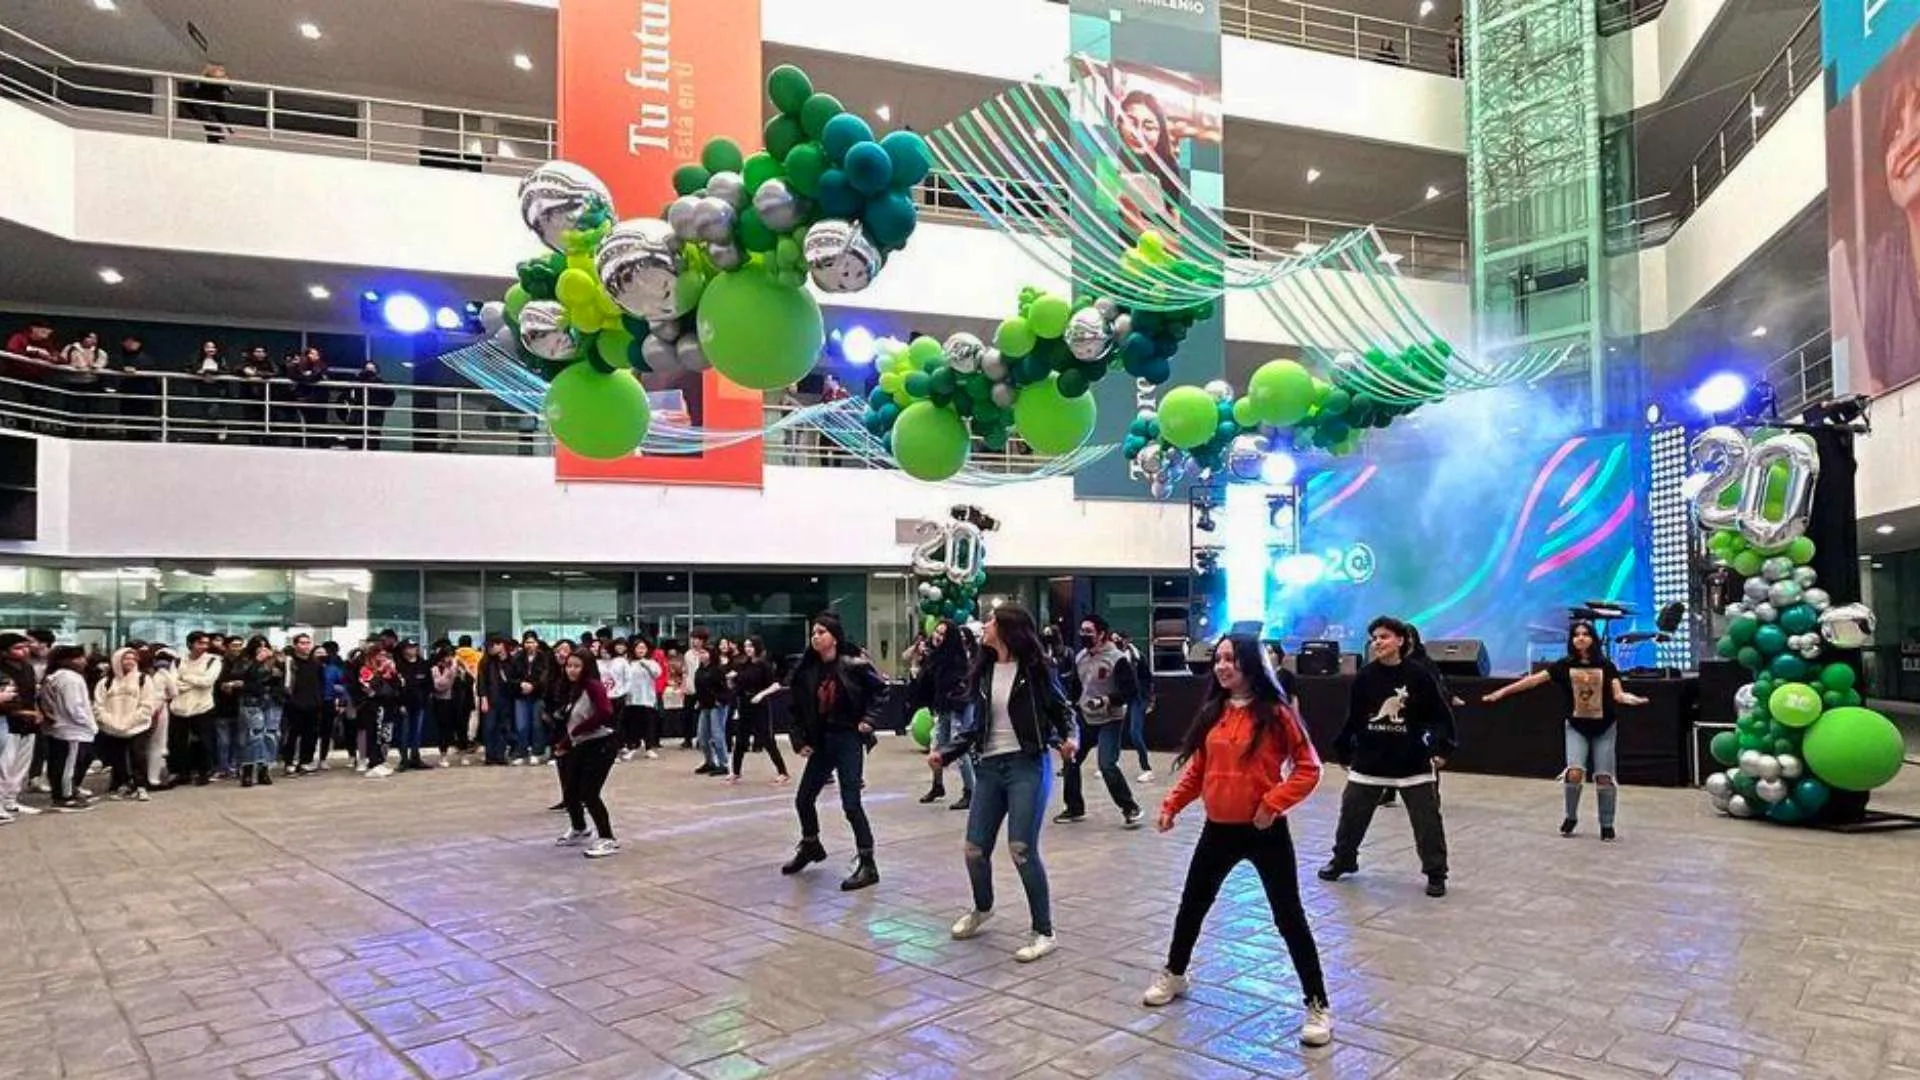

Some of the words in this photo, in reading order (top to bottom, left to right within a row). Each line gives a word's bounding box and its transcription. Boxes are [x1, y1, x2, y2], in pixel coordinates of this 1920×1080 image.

[676, 84, 696, 110] en
[628, 103, 670, 156] Tu
[1690, 425, 1820, 554] 20
[912, 519, 983, 585] 20
